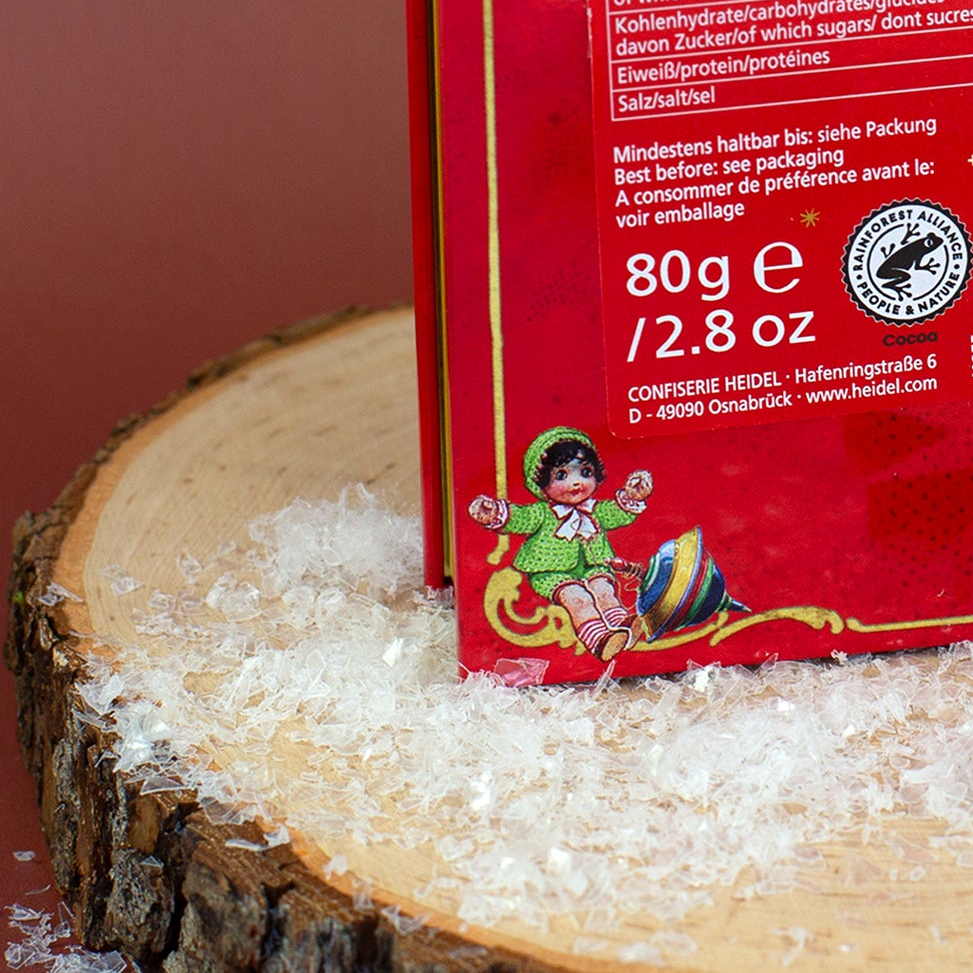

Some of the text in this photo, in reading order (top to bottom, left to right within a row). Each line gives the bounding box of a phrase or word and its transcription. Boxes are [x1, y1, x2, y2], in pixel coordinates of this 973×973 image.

[615, 38, 670, 56] davon
[674, 25, 757, 50] Zucker/of
[760, 20, 812, 41] which
[816, 14, 877, 39] sugars/
[881, 11, 922, 30] dont
[617, 49, 830, 82] Eiweiß/protein/protéines
[617, 85, 715, 112] Salz/salt/sel
[613, 117, 936, 163] Mindestens haltbar bis: siehe Packung
[614, 147, 844, 185] Best before: see packaging
[615, 158, 934, 207] A consommer de préférence avant le:
[615, 201, 745, 228] voir emballage
[853, 210, 963, 271] RAINFOREST ALLIANCE
[626, 250, 730, 301] 80g
[857, 272, 960, 315] PEOPLE & NATURE
[752, 311, 816, 347] oz
[883, 332, 938, 347] Cocoa
[627, 353, 937, 402] CONFISERIE HEIDEL Hafenringstraße 6
[629, 377, 937, 424] D 49090 Osnabrück www.heidel.com
